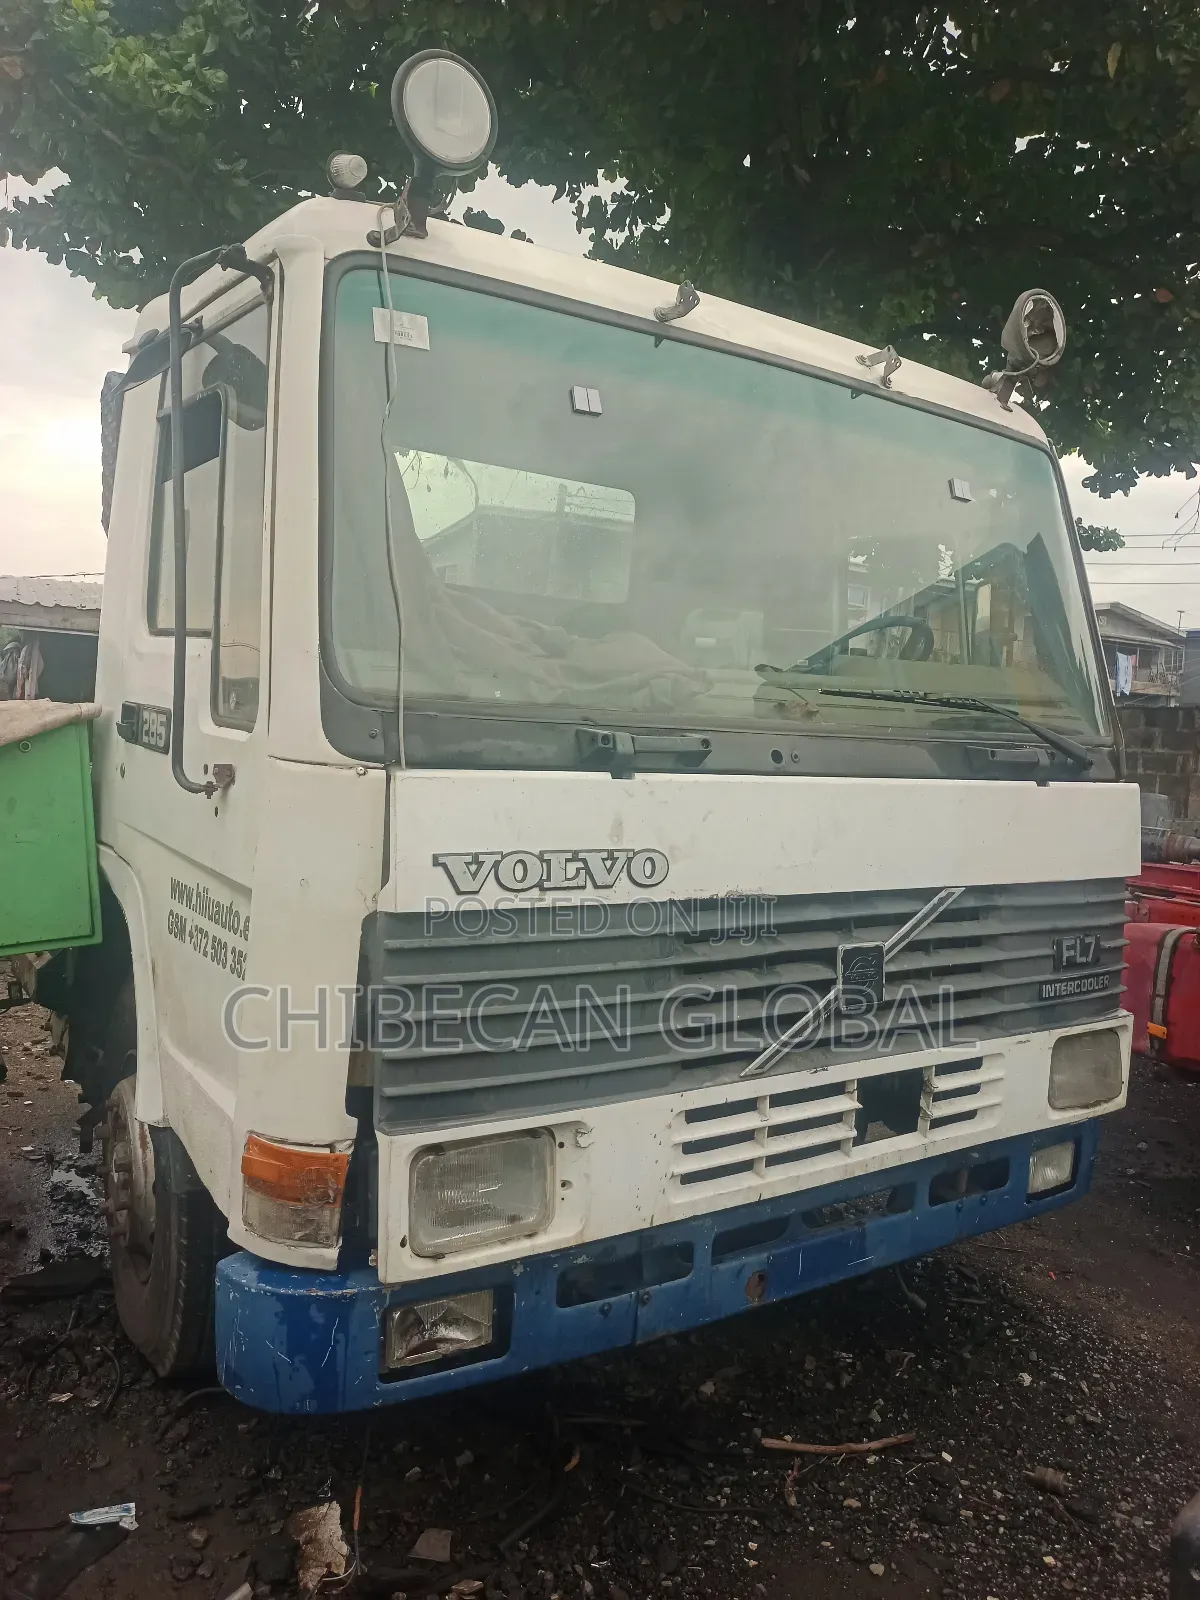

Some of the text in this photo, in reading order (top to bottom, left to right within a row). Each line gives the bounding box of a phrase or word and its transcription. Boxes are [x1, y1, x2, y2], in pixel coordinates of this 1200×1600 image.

[142, 710, 167, 748] 285
[433, 848, 669, 895] VOLVO
[167, 908, 187, 944] GSM
[188, 924, 209, 958] +372
[210, 934, 228, 969] 503
[1062, 935, 1096, 966] FL7
[1042, 974, 1110, 998] INTERCOOLER
